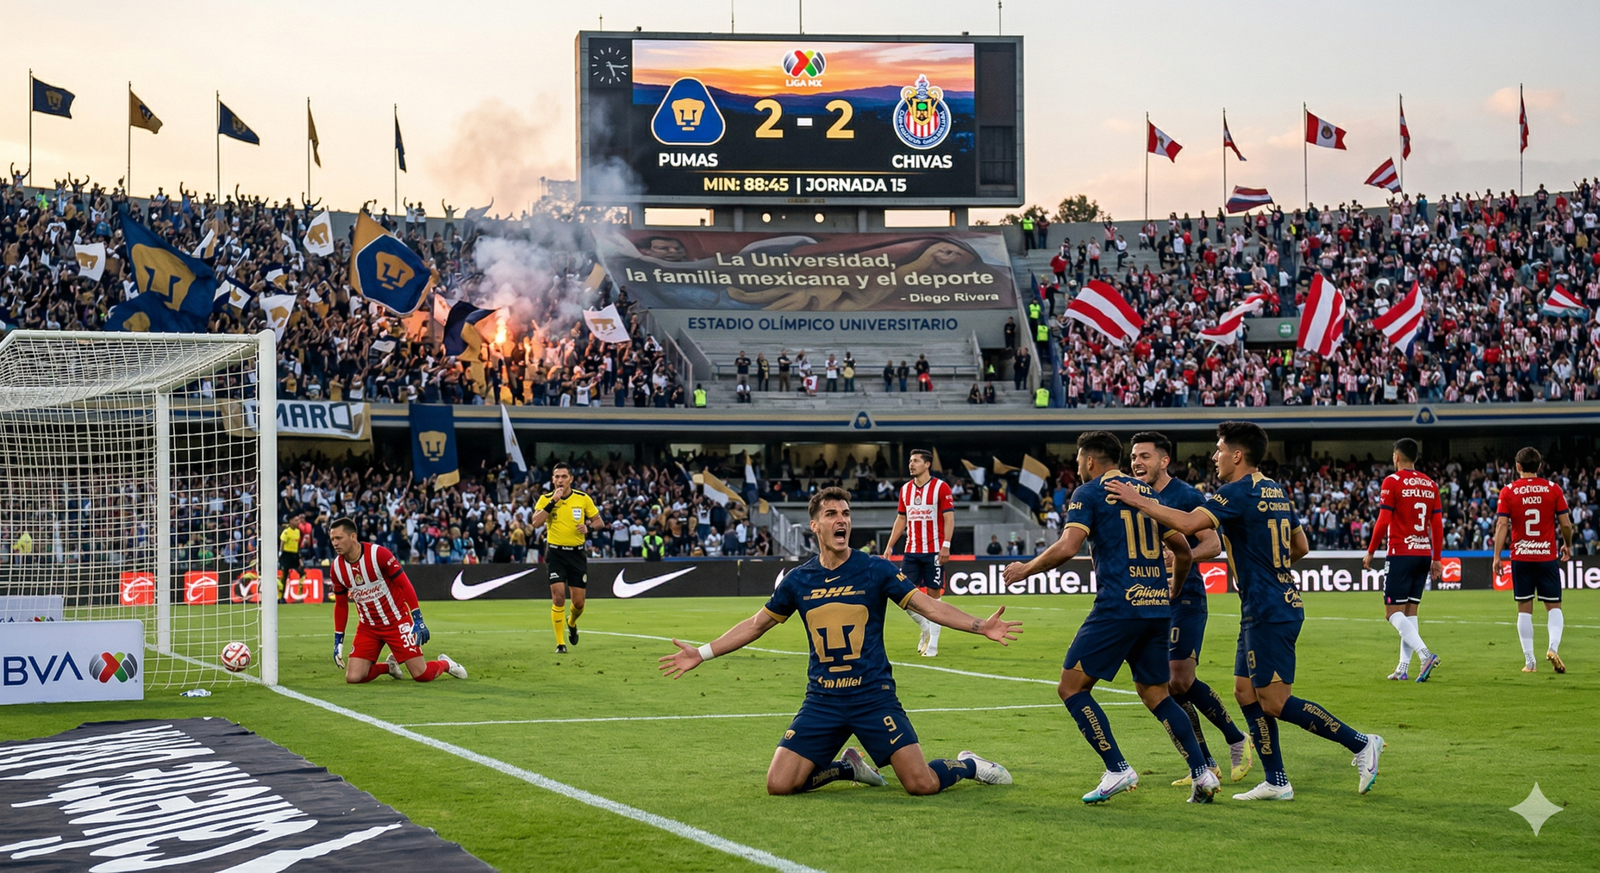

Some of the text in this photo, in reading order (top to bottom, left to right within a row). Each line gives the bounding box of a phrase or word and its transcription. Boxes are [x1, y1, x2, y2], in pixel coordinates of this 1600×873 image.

[785, 79, 807, 87] LIGA
[754, 99, 784, 138] 2
[825, 99, 855, 139] 2
[659, 153, 719, 167] PUMAS
[892, 155, 953, 169] CHIVAS
[703, 178, 741, 191] MIN:
[744, 178, 789, 191] 88:45
[806, 178, 887, 192] JORNADA
[890, 178, 907, 192] 15
[716, 252, 896, 269] La Universidad,
[626, 268, 994, 290] la familia mexicana y el deporte
[910, 293, 950, 304] Diego
[954, 292, 999, 302] Rivera
[688, 316, 958, 331] ESTADIO OLÍMPICO UNIVERSITARIO
[1522, 496, 1543, 505] MOZO
[1414, 502, 1427, 531] 3
[1525, 509, 1541, 536] 2
[1120, 509, 1161, 559] 10
[1268, 518, 1291, 568] 19
[1129, 566, 1160, 577] SALVIO
[810, 585, 856, 599] DHL
[401, 634, 417, 648] 30
[836, 676, 862, 688] Mifel
[883, 715, 897, 732] 9
